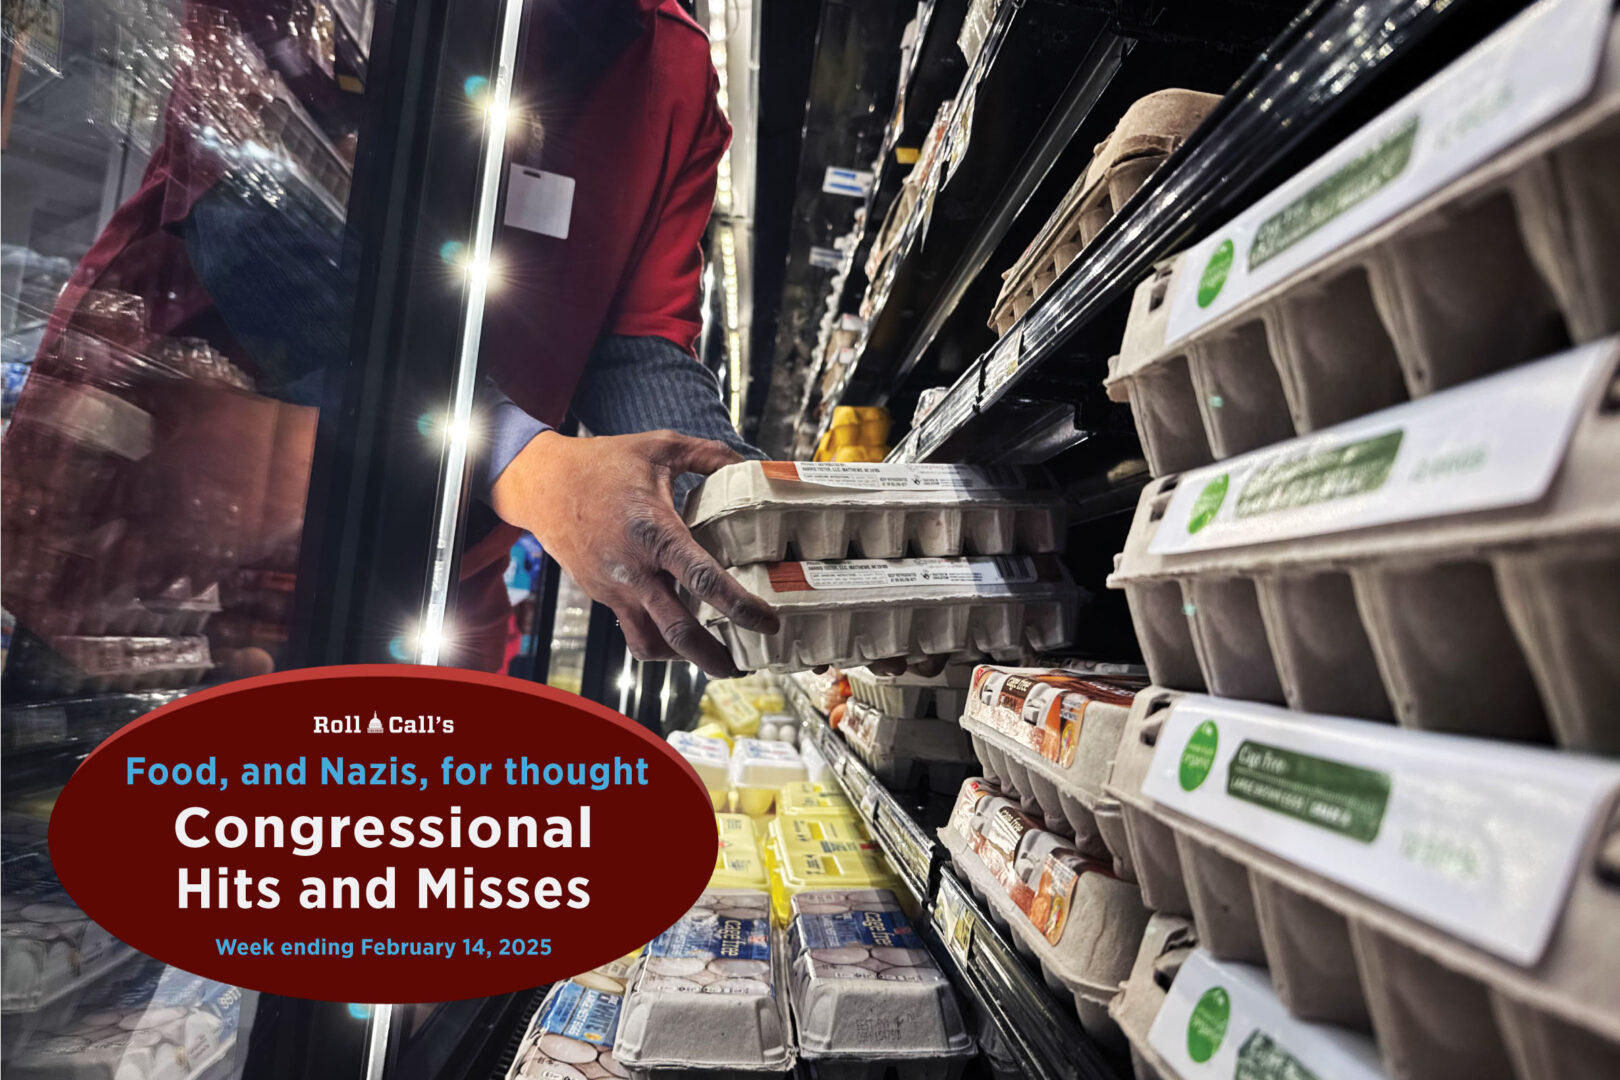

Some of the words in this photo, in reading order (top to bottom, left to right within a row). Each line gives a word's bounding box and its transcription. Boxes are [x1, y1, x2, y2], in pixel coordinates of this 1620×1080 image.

[719, 920, 742, 940] cage
[862, 912, 886, 931] cage
[721, 940, 746, 956] free
